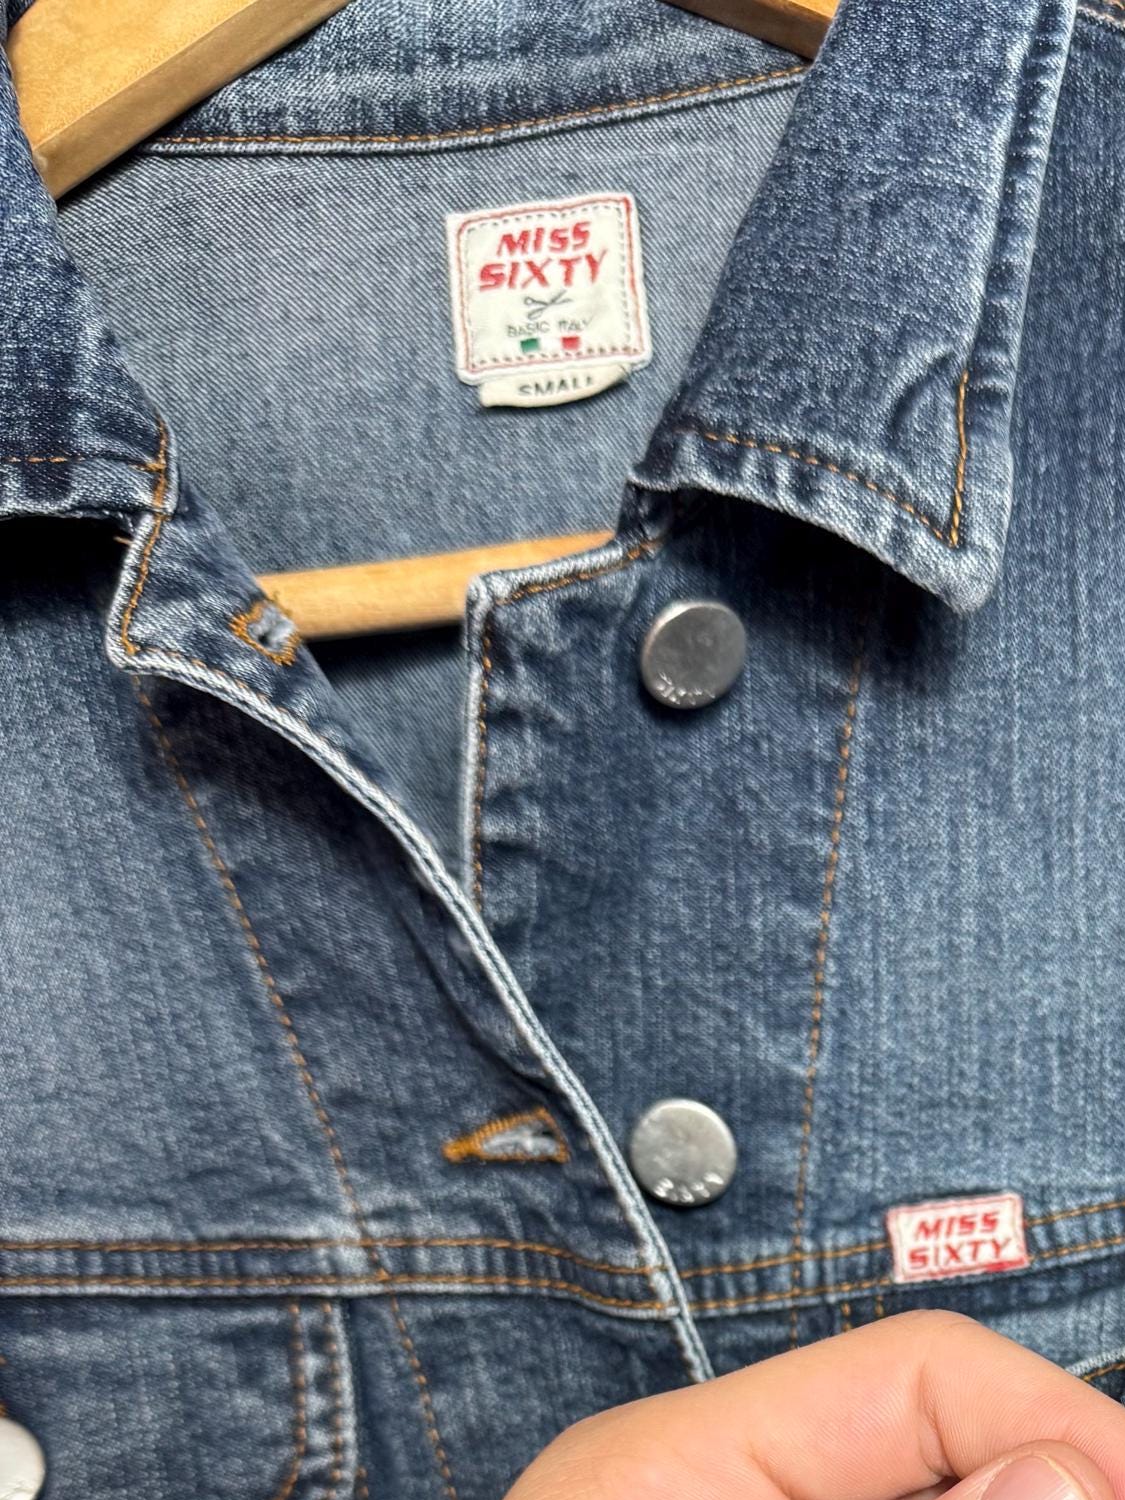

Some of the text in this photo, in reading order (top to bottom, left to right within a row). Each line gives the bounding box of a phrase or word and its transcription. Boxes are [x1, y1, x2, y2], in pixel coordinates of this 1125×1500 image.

[497, 221, 592, 256] MISS
[479, 249, 607, 292] SIXTY
[507, 317, 593, 337] BASIC ITALY
[518, 376, 593, 396] SMALL
[914, 1212, 999, 1240] MISS
[908, 1238, 1011, 1269] SIXTY
